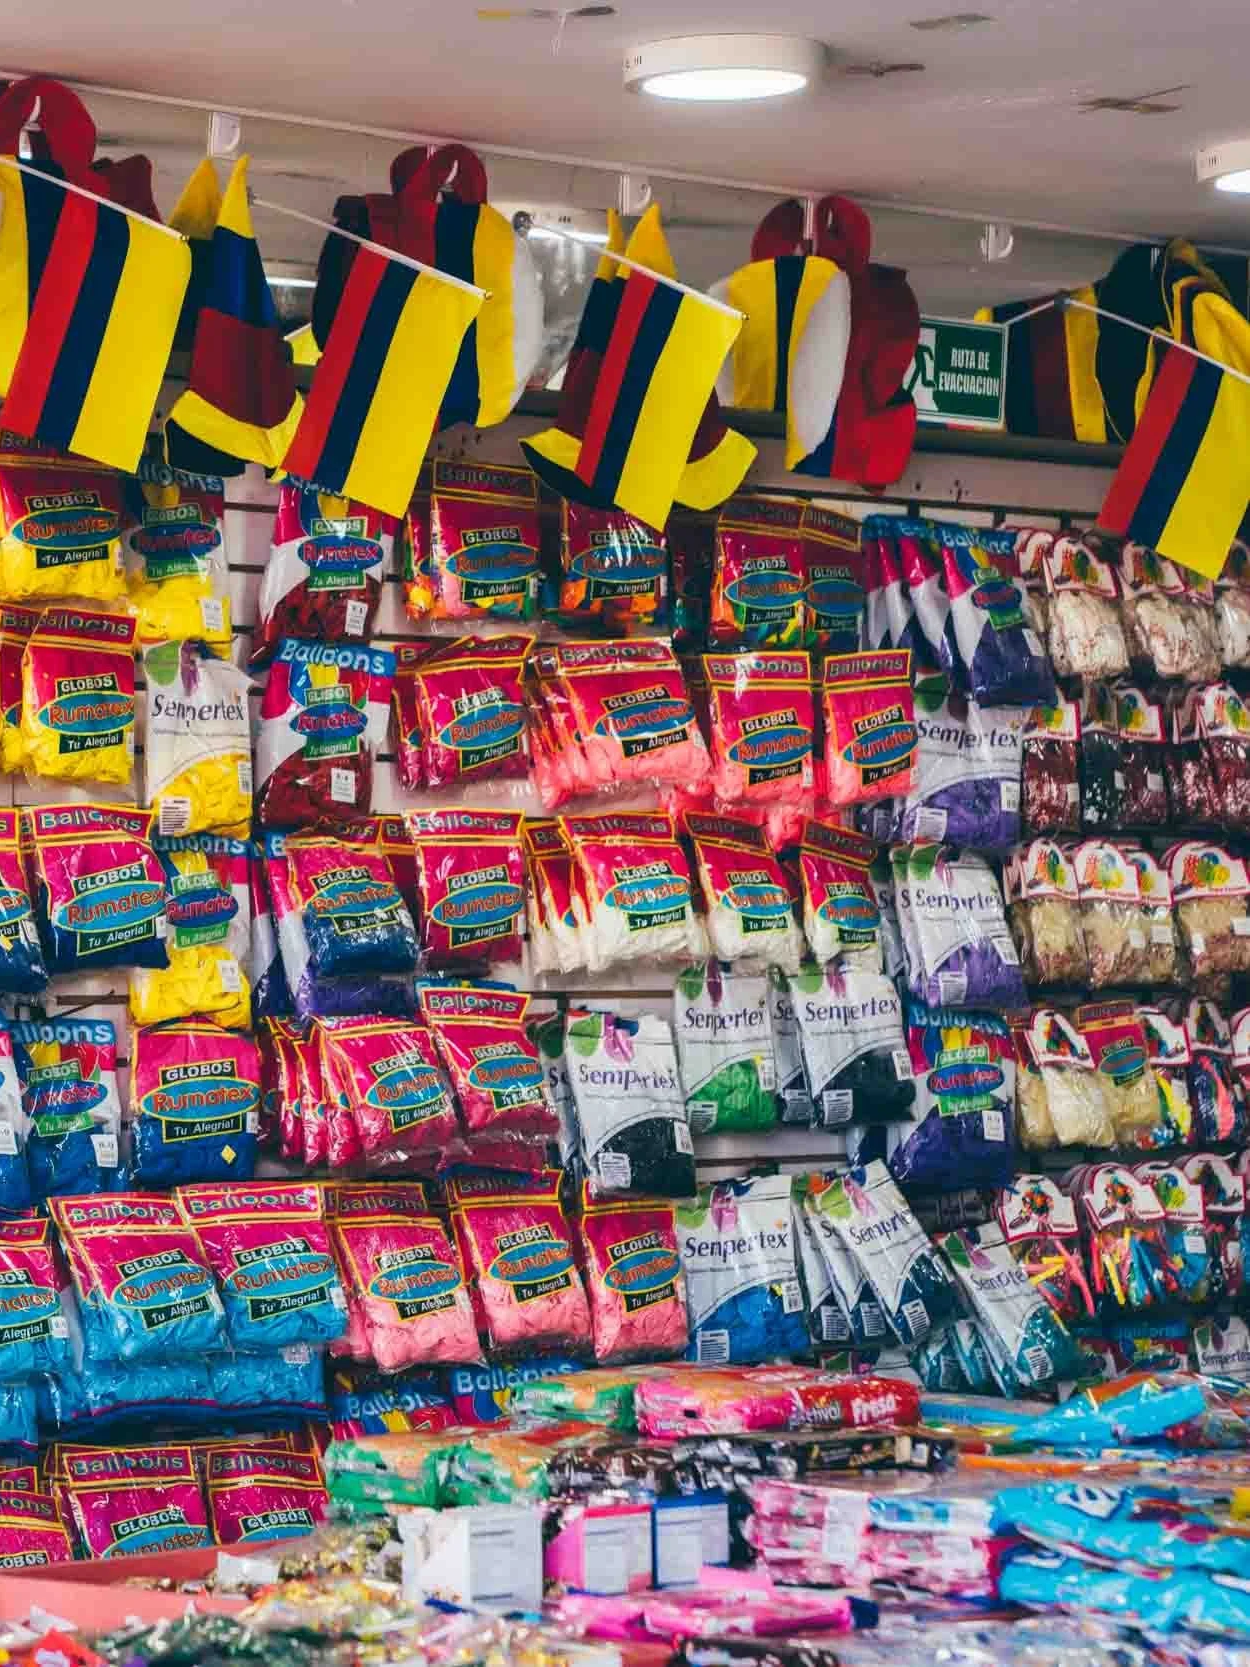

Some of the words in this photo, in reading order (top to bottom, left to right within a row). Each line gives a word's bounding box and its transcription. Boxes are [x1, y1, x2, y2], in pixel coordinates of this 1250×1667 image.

[951, 347, 976, 369] RUTA
[977, 351, 990, 371] DE
[32, 494, 95, 509] GLOBOS
[466, 530, 519, 544] GLOBOS
[282, 640, 385, 673] Balloons
[61, 675, 113, 694] GLOBOS
[610, 688, 665, 708] GLOBOS
[50, 699, 135, 725] Rumatex
[152, 694, 245, 727] Sempertex
[746, 713, 794, 731] GLOBOS
[68, 740, 81, 750] Tu
[630, 742, 644, 754] Tu
[78, 866, 141, 890] GLOBOS
[452, 869, 504, 889] GLOBOS
[67, 889, 166, 924] Rumatex
[638, 918, 648, 926] Tu
[89, 936, 102, 947] Tu
[458, 931, 470, 941] Tu
[430, 995, 517, 1013] Balloons
[806, 996, 899, 1027] Sempertex
[685, 1006, 765, 1037] Sempertex
[166, 1061, 232, 1080] GLOBOS
[153, 1085, 254, 1113] Rumatex
[174, 1125, 191, 1136] Tu
[189, 1189, 309, 1213] Balloons
[73, 1205, 174, 1222] Balloons
[501, 1228, 549, 1248] GLOBOS
[240, 1241, 305, 1262] GLOBOS
[124, 1253, 181, 1275] GLOBOS
[232, 1261, 332, 1289] Rumatex
[121, 1271, 209, 1301] Rumatex
[152, 1311, 165, 1322] Tu
[259, 1303, 275, 1314] Tu
[852, 1393, 901, 1424] Fresa
[73, 1455, 183, 1476] Balloons
[212, 1454, 311, 1475] Balloons
[118, 1510, 185, 1534] GLOBOS
[247, 1509, 307, 1530] GLOBOS
